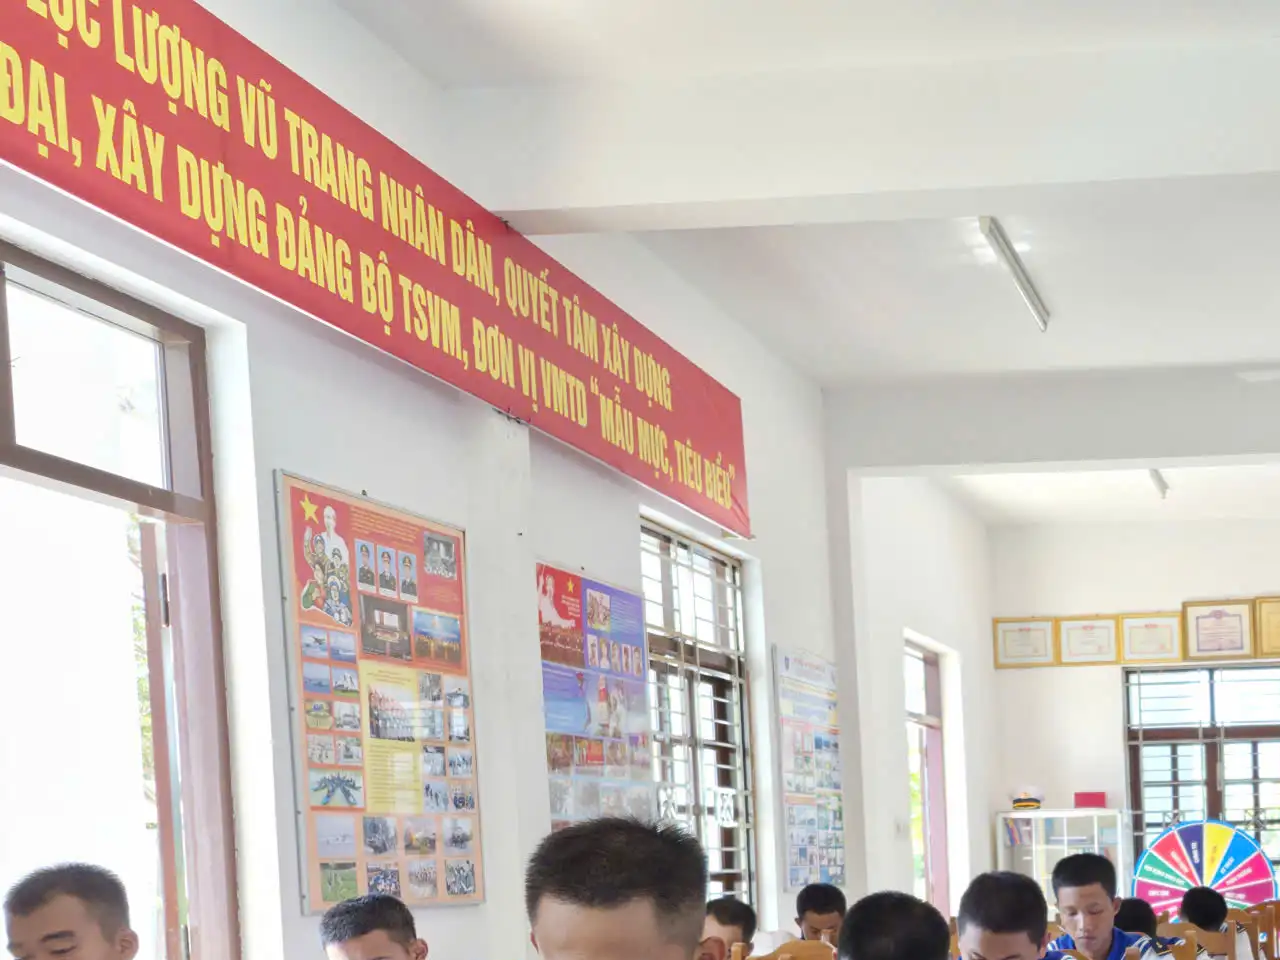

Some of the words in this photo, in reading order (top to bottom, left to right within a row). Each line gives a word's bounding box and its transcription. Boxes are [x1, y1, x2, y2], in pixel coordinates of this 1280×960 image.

[92, 94, 165, 202] XÂY
[177, 144, 269, 258] DỰNG
[276, 196, 354, 304] ĐẢNG
[360, 251, 394, 336] BỘ
[399, 273, 469, 370] TSVM,
[473, 317, 516, 389] ĐƠN
[518, 344, 539, 413] VỊ
[541, 358, 588, 428] VMTD
[637, 416, 674, 482] MỰC,
[674, 439, 703, 495] TIÊU
[113, 0, 230, 132] LƯỢNG
[237, 75, 278, 160] VŨ
[284, 107, 374, 222] TRANG
[380, 171, 446, 266] NHÂN
[451, 219, 500, 306] DÂN,
[504, 258, 559, 337] QUYẾT
[563, 295, 599, 363] TÂM
[602, 324, 631, 384] XÂY
[634, 347, 673, 412] DỰNG
